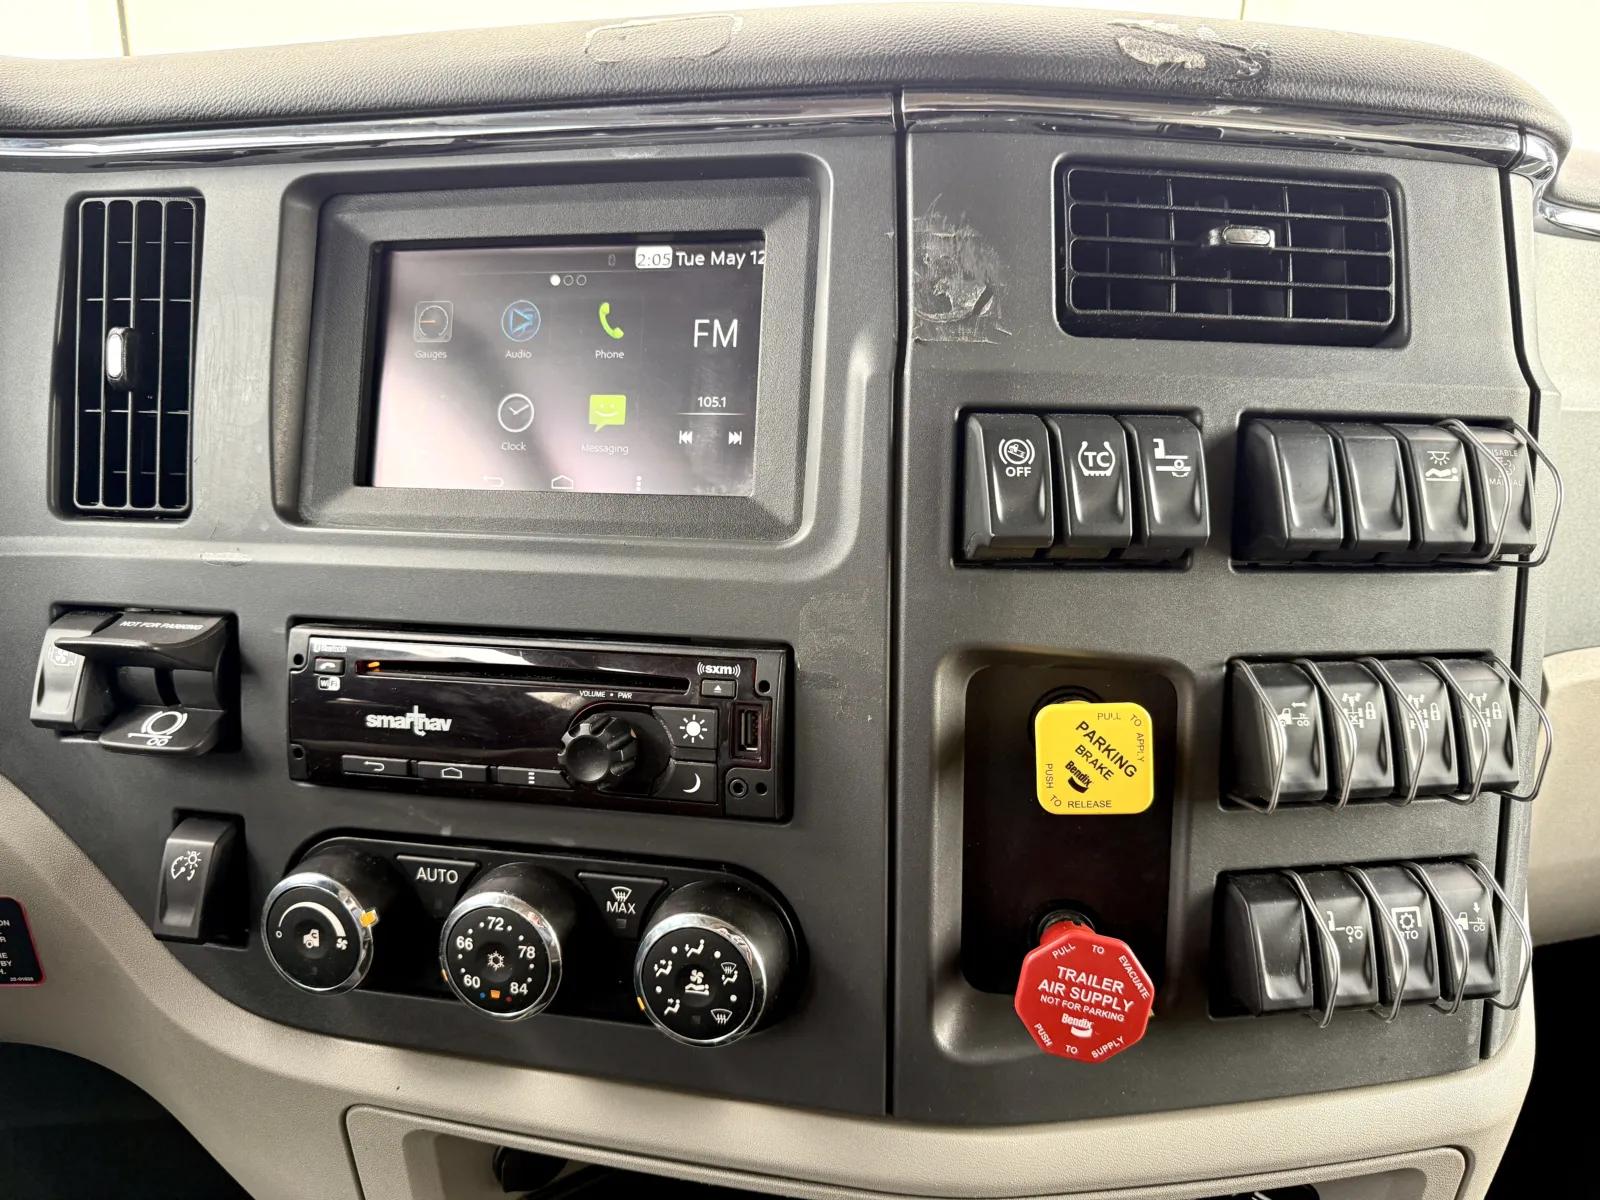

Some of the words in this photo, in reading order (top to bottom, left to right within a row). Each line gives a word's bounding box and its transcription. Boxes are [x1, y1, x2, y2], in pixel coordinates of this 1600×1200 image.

[637, 252, 671, 267] 2:05
[676, 251, 705, 267] Tue
[710, 251, 746, 269] May
[693, 318, 739, 348] FM
[414, 350, 448, 361] Gauges
[504, 349, 532, 360] Audio
[595, 349, 625, 360] Phone
[697, 396, 727, 408] 105.1
[501, 440, 527, 452] Clock
[581, 443, 629, 456] Messaging
[1084, 451, 1111, 468] TC
[1005, 466, 1032, 478] OFF
[119, 620, 142, 628] NOT
[141, 621, 161, 629] FOR
[160, 622, 204, 631] PARKING
[579, 690, 606, 698] VOLUME
[617, 691, 633, 699] PWR
[365, 705, 453, 737] smartnav
[1097, 712, 1121, 720] PULL
[1130, 714, 1142, 727] TO
[1136, 732, 1145, 762] APPLY
[1075, 720, 1138, 778] PARKING
[1074, 744, 1115, 781] BRAKE
[1064, 760, 1094, 788] Bendix
[1044, 763, 1053, 789] PUSH
[1050, 794, 1062, 807] TO
[1067, 800, 1112, 809] RELEASE
[416, 866, 459, 884] AUTO
[606, 900, 636, 914] MAX
[487, 916, 505, 931] 72
[456, 935, 474, 951] 66
[518, 945, 536, 959] 78
[1052, 943, 1076, 959] PULL
[1091, 944, 1105, 955] TO
[1118, 955, 1150, 1000] EVACUATE
[1057, 965, 1124, 995] TRAILER
[463, 974, 481, 989] 60
[510, 981, 529, 996] 84
[1037, 979, 1066, 997] AIR
[1069, 986, 1134, 1013] SUPPLY
[1040, 994, 1060, 1006] NOT
[1061, 999, 1082, 1012] FOR
[1083, 1005, 1125, 1022] PARKING
[1061, 1013, 1093, 1030] Bendix
[1034, 1023, 1053, 1047] PUSH
[1065, 1044, 1078, 1055] TO
[1091, 1036, 1125, 1058] SUPPLY
